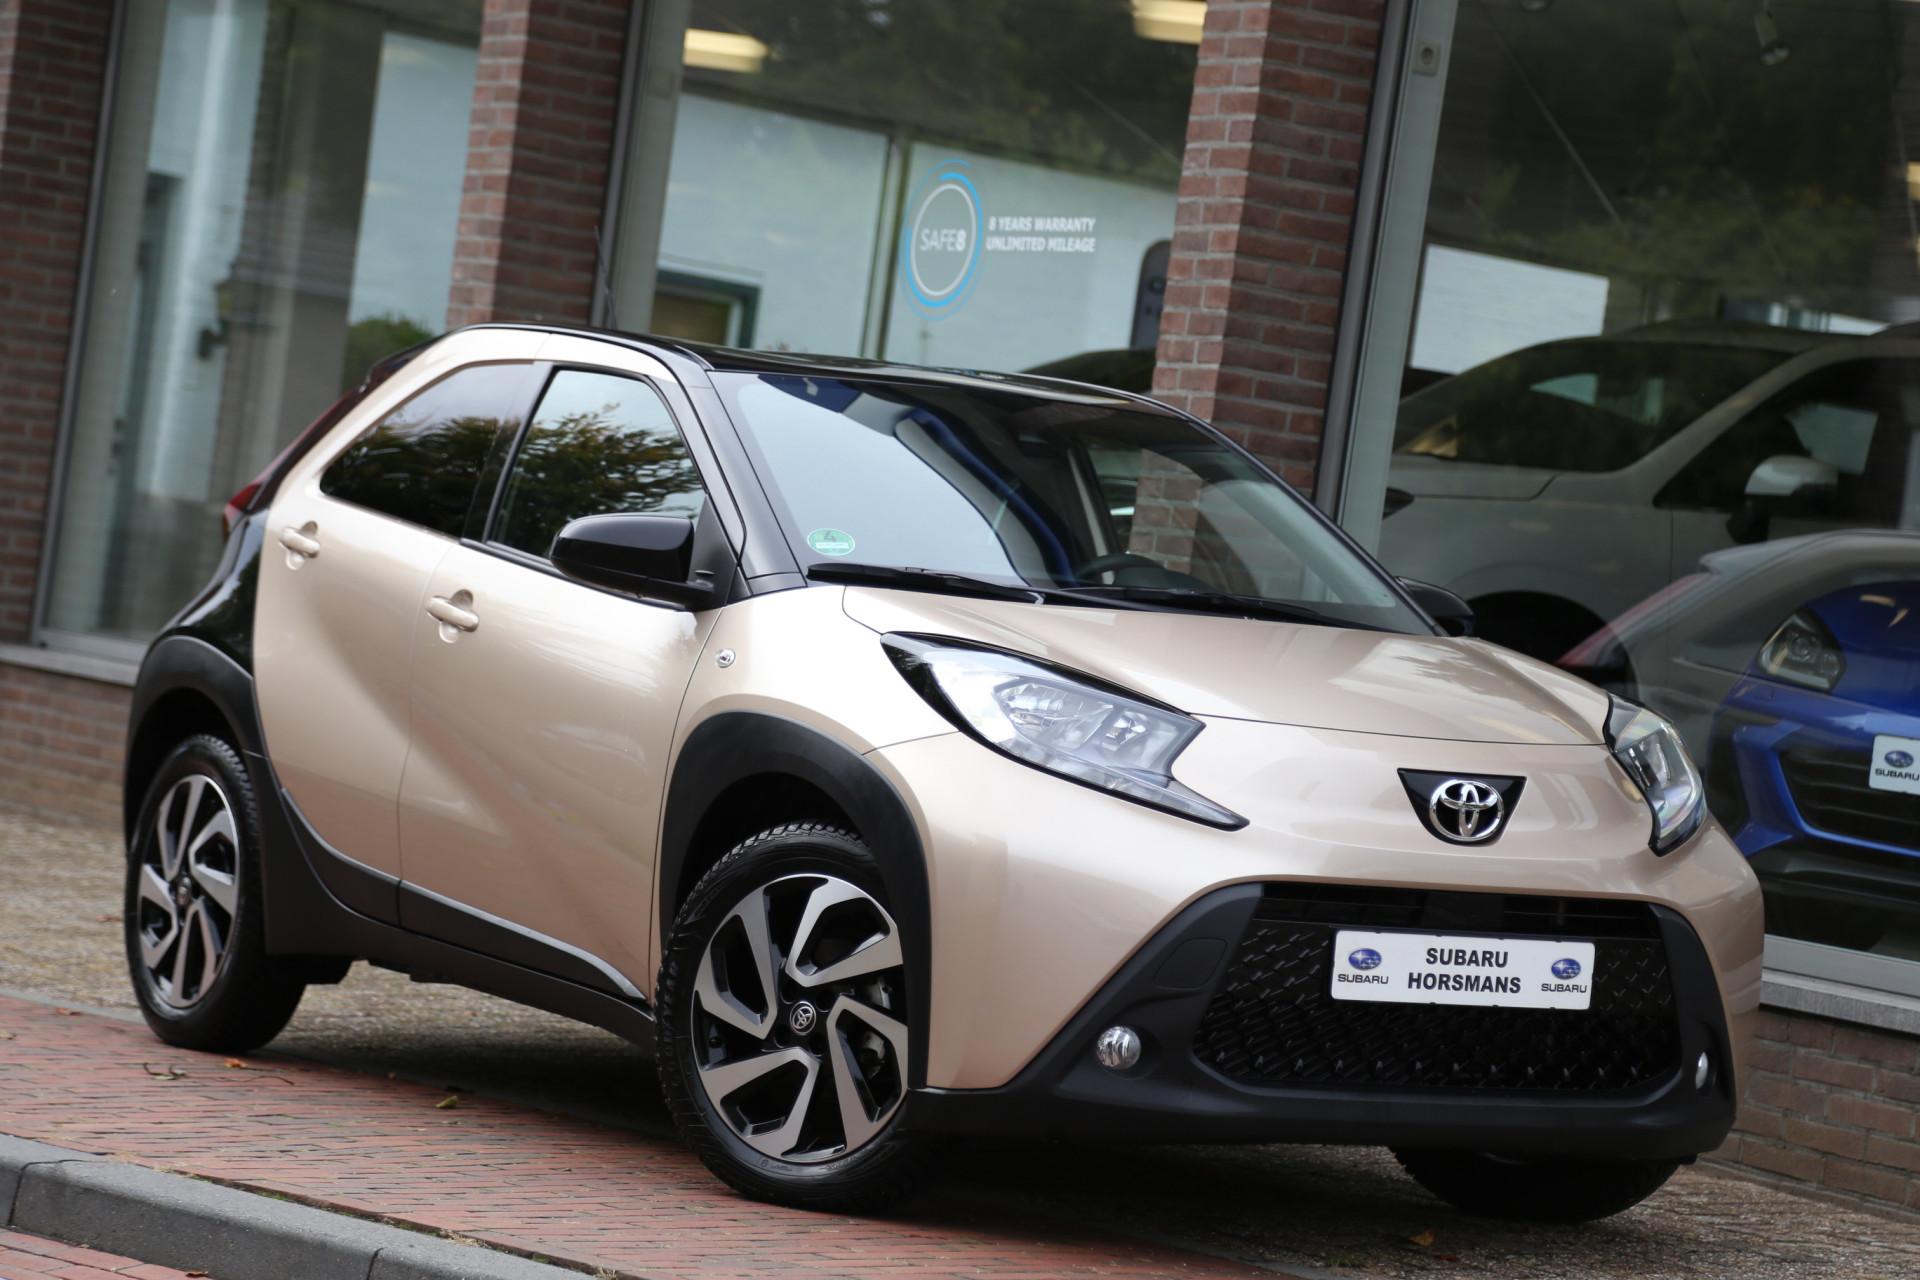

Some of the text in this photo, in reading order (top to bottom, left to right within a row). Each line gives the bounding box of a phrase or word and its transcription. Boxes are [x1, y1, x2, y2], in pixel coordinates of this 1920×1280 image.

[988, 216, 1096, 232] 8 YEARS WARRANTY
[920, 228, 967, 251] SAFE8
[986, 236, 1096, 252] UNLIMITED MILEAGE
[1875, 768, 1920, 781] SUBARU
[1426, 947, 1509, 968] SUBARU
[1337, 973, 1389, 985] SUBARU
[1407, 972, 1521, 993] HORSMANS
[1541, 983, 1587, 993] SUBARU
